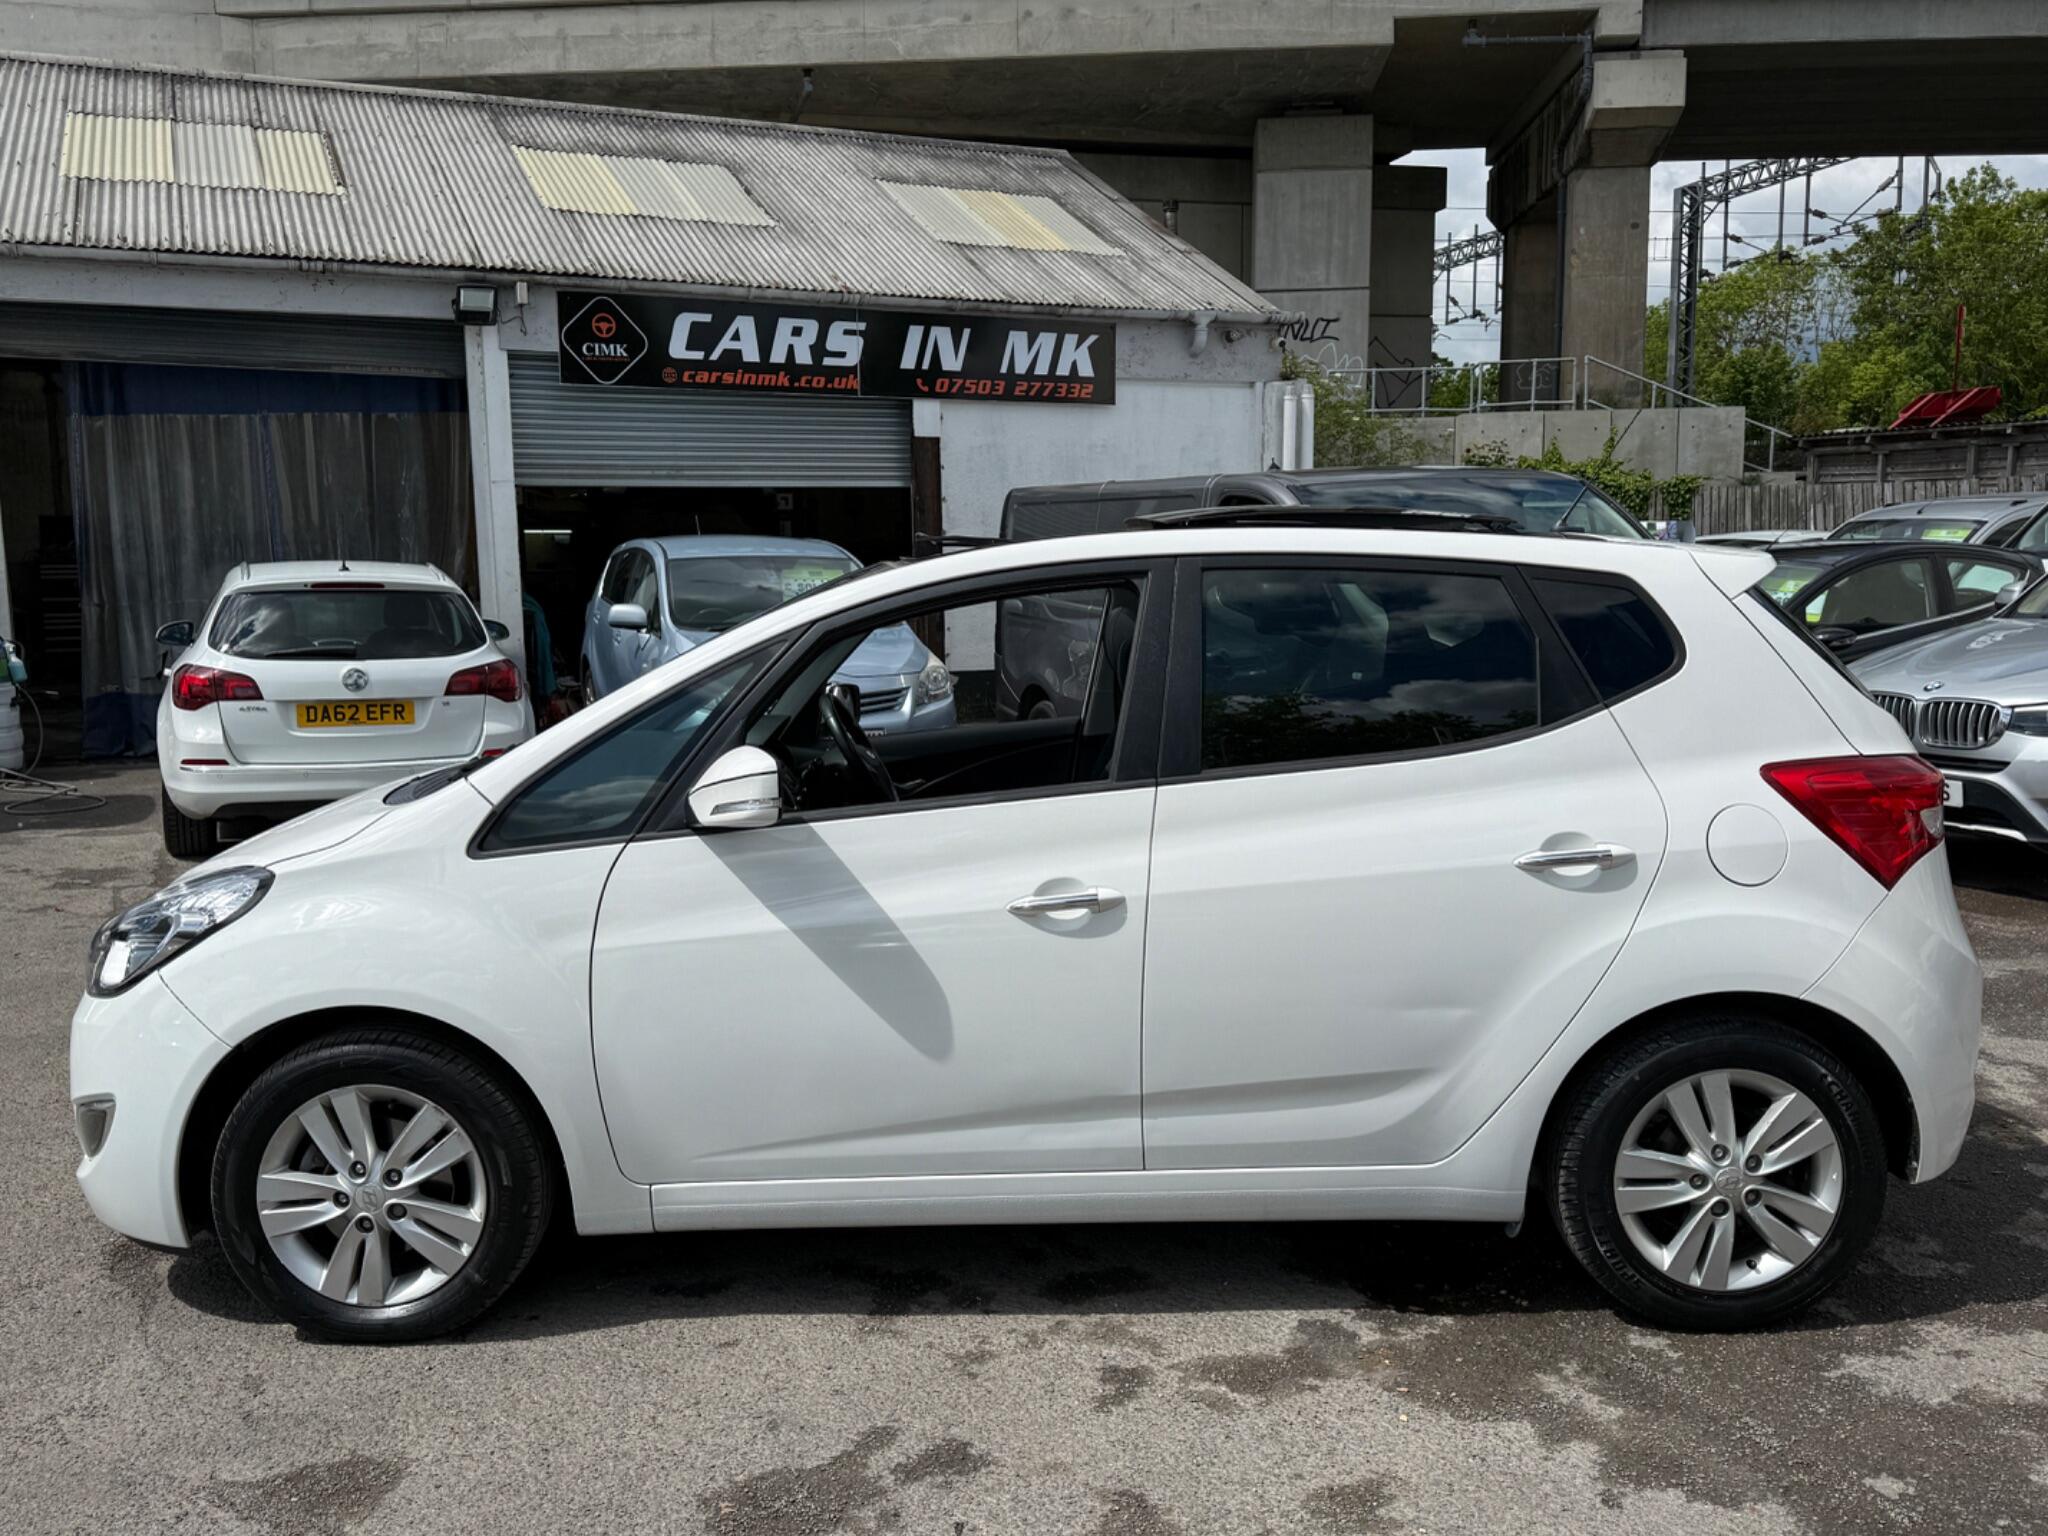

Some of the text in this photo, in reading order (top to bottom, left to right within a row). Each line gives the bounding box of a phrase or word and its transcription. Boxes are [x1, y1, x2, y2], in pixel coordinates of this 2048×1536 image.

[581, 342, 629, 357] CIMK
[667, 311, 1099, 377] CARS IN MK
[934, 378, 1094, 398] 07503 277332
[305, 703, 406, 723] DA62 EFR
